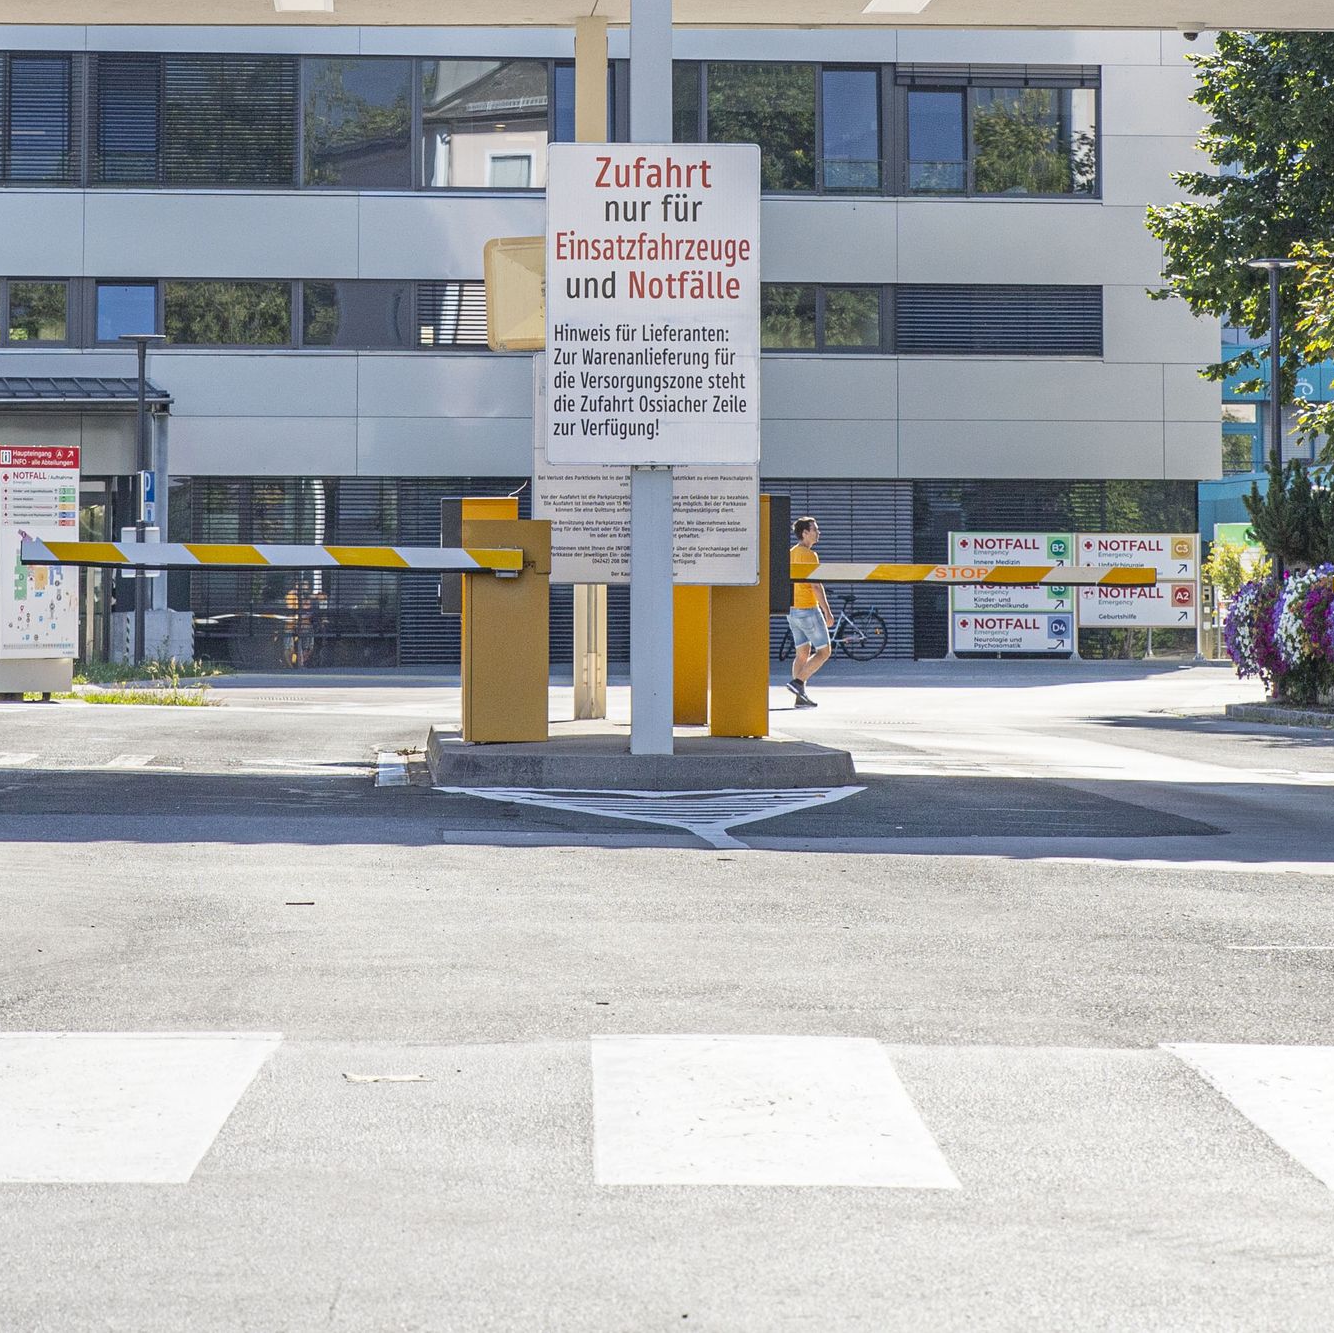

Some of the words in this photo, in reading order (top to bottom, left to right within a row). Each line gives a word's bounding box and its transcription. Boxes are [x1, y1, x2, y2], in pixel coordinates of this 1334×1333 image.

[595, 156, 712, 189] Zufahrt
[605, 199, 651, 222] nur
[661, 193, 703, 223] für
[556, 231, 751, 268] Einsatzfahrzeuge
[566, 270, 616, 299] und
[629, 269, 740, 300] Notfälle
[554, 324, 610, 342] Hinweis
[616, 324, 637, 342] für
[642, 324, 729, 342] Lieferanten:
[554, 347, 578, 365] Zur
[582, 347, 709, 369] Warenanlieferung
[715, 347, 736, 365] für
[554, 371, 575, 389] die
[580, 371, 703, 393] Versorgungszone
[709, 371, 746, 389] steht
[554, 395, 575, 413] die
[580, 395, 635, 413] Zufahrt
[639, 395, 708, 413] Ossiacher
[713, 395, 747, 413] Zeile
[553, 423, 576, 436] zur
[580, 418, 659, 441] Verfügung!
[13, 450, 52, 458] Haupteingang
[13, 472, 46, 480] NOTFALL
[974, 539, 1040, 550] NOTFALL
[1052, 544, 1065, 552] B2
[1098, 540, 1163, 551] NOTFALL
[935, 567, 988, 579] STOP
[1098, 586, 1163, 598] NOTFALL
[1176, 592, 1189, 600] A2
[974, 619, 1040, 629] NOTFALL
[1052, 624, 1065, 632] D4
